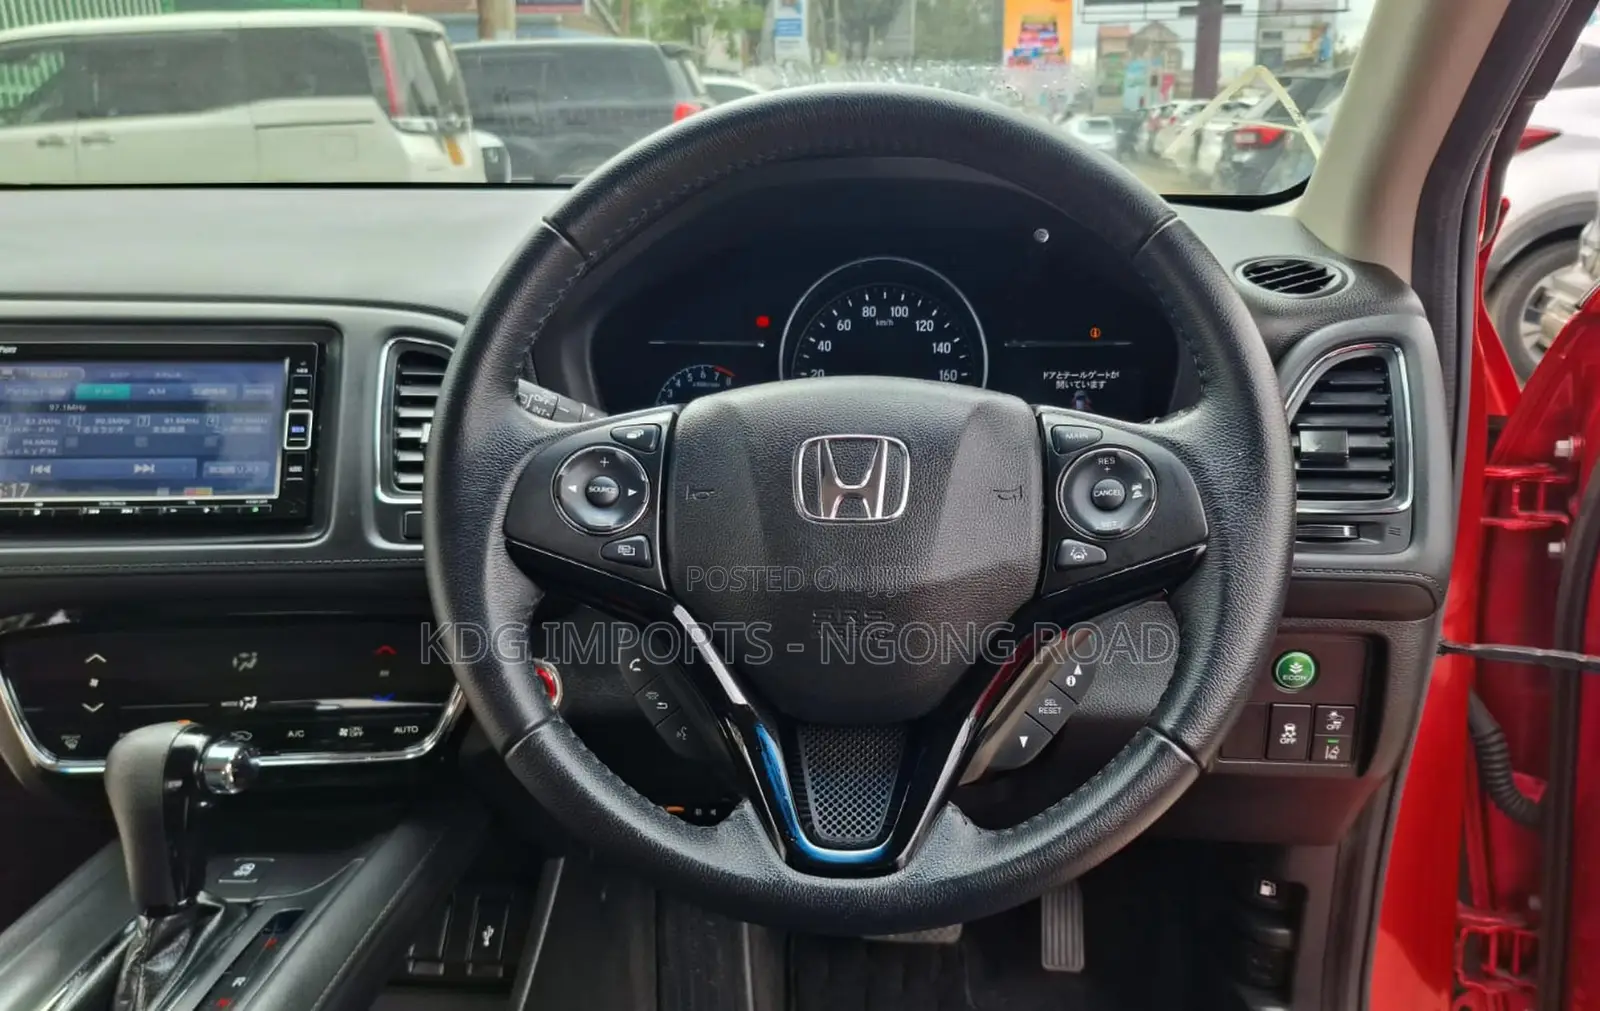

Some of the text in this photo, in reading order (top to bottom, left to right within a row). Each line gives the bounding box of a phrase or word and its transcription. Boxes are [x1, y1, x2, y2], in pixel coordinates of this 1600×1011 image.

[862, 305, 877, 318] 80
[890, 305, 909, 318] 100
[836, 319, 851, 331] 60
[915, 319, 934, 332] 120
[817, 340, 832, 352] 40
[932, 342, 951, 354] 140
[687, 373, 693, 382] 5
[700, 370, 707, 379] 6
[811, 369, 825, 377] 20
[939, 369, 958, 381] 160
[1043, 370, 1120, 380] ドアとテールゲートが
[667, 389, 673, 398] 3
[1098, 457, 1116, 465] RES
[1093, 488, 1122, 497] CANCEL
[1038, 706, 1062, 715] RESET
[393, 725, 419, 733] AUTO
[287, 730, 304, 738] A/C
